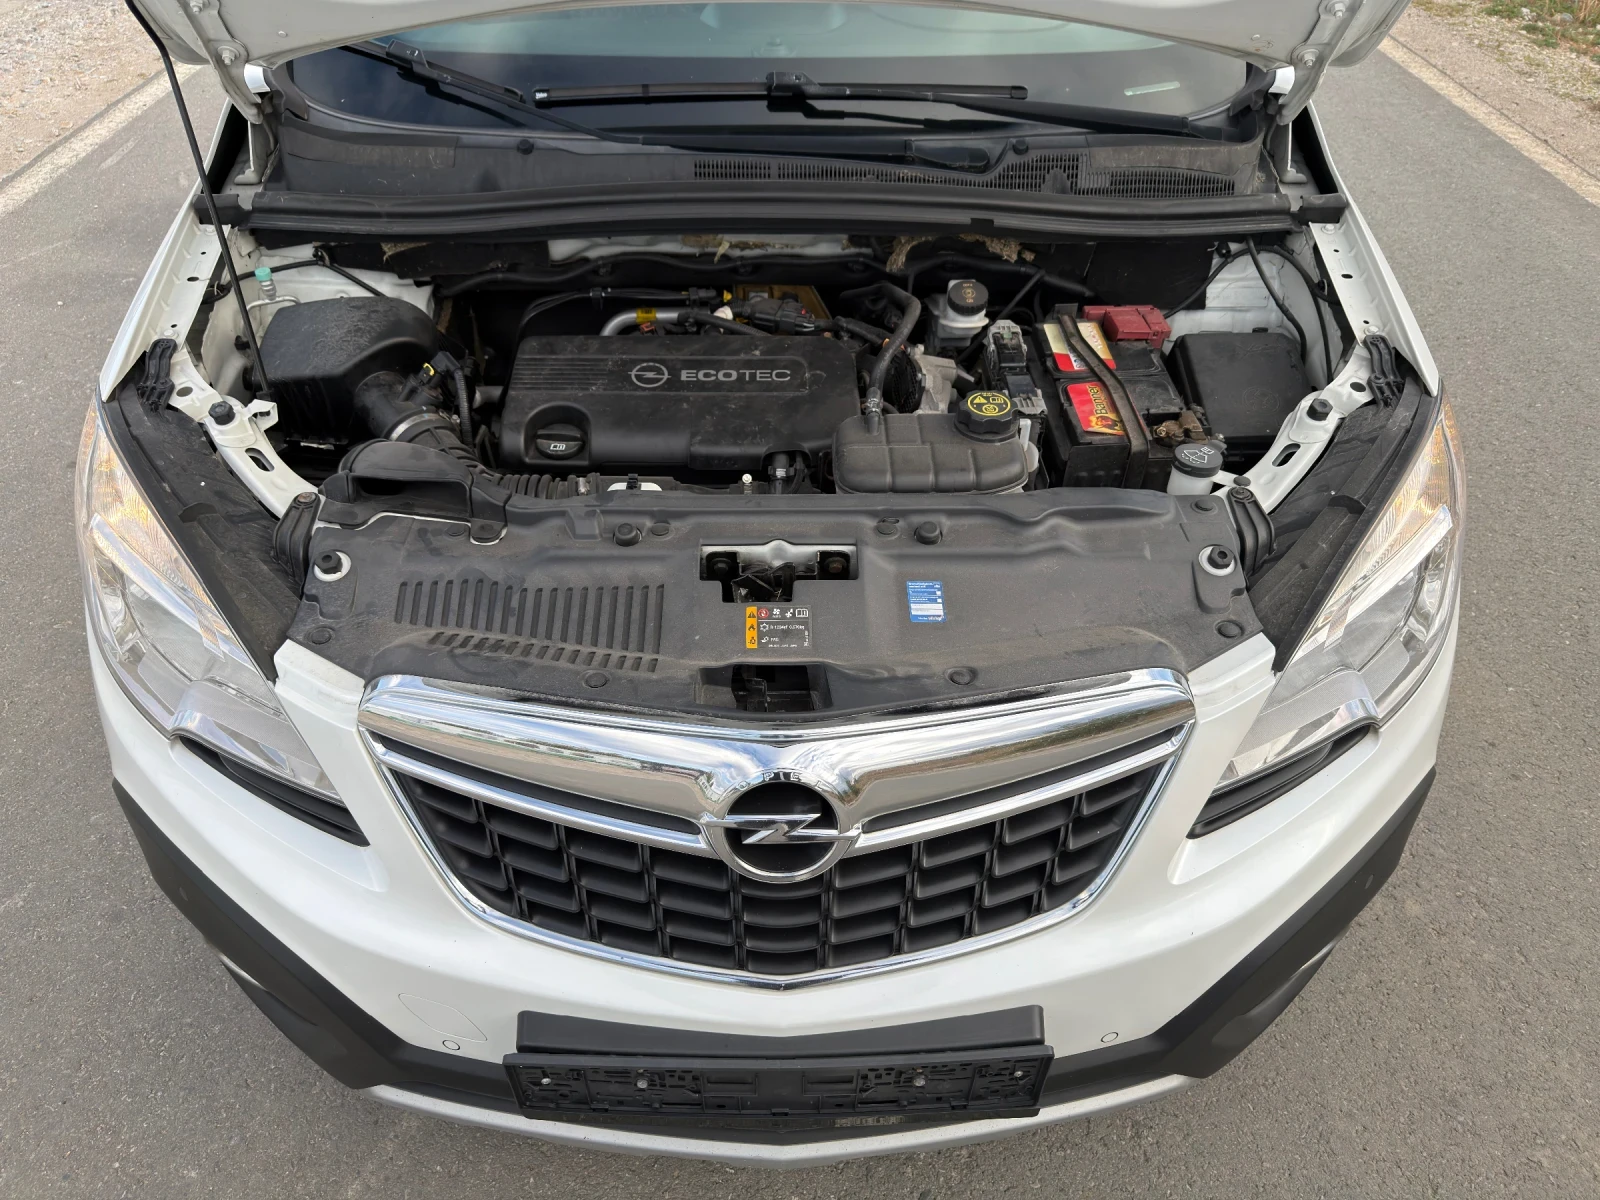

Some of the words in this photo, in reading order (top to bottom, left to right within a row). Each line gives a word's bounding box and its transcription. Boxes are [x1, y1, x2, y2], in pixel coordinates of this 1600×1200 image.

[680, 369, 791, 381] ECOTEC
[1088, 385, 1108, 415] Banner
[737, 771, 823, 791] OPEL
